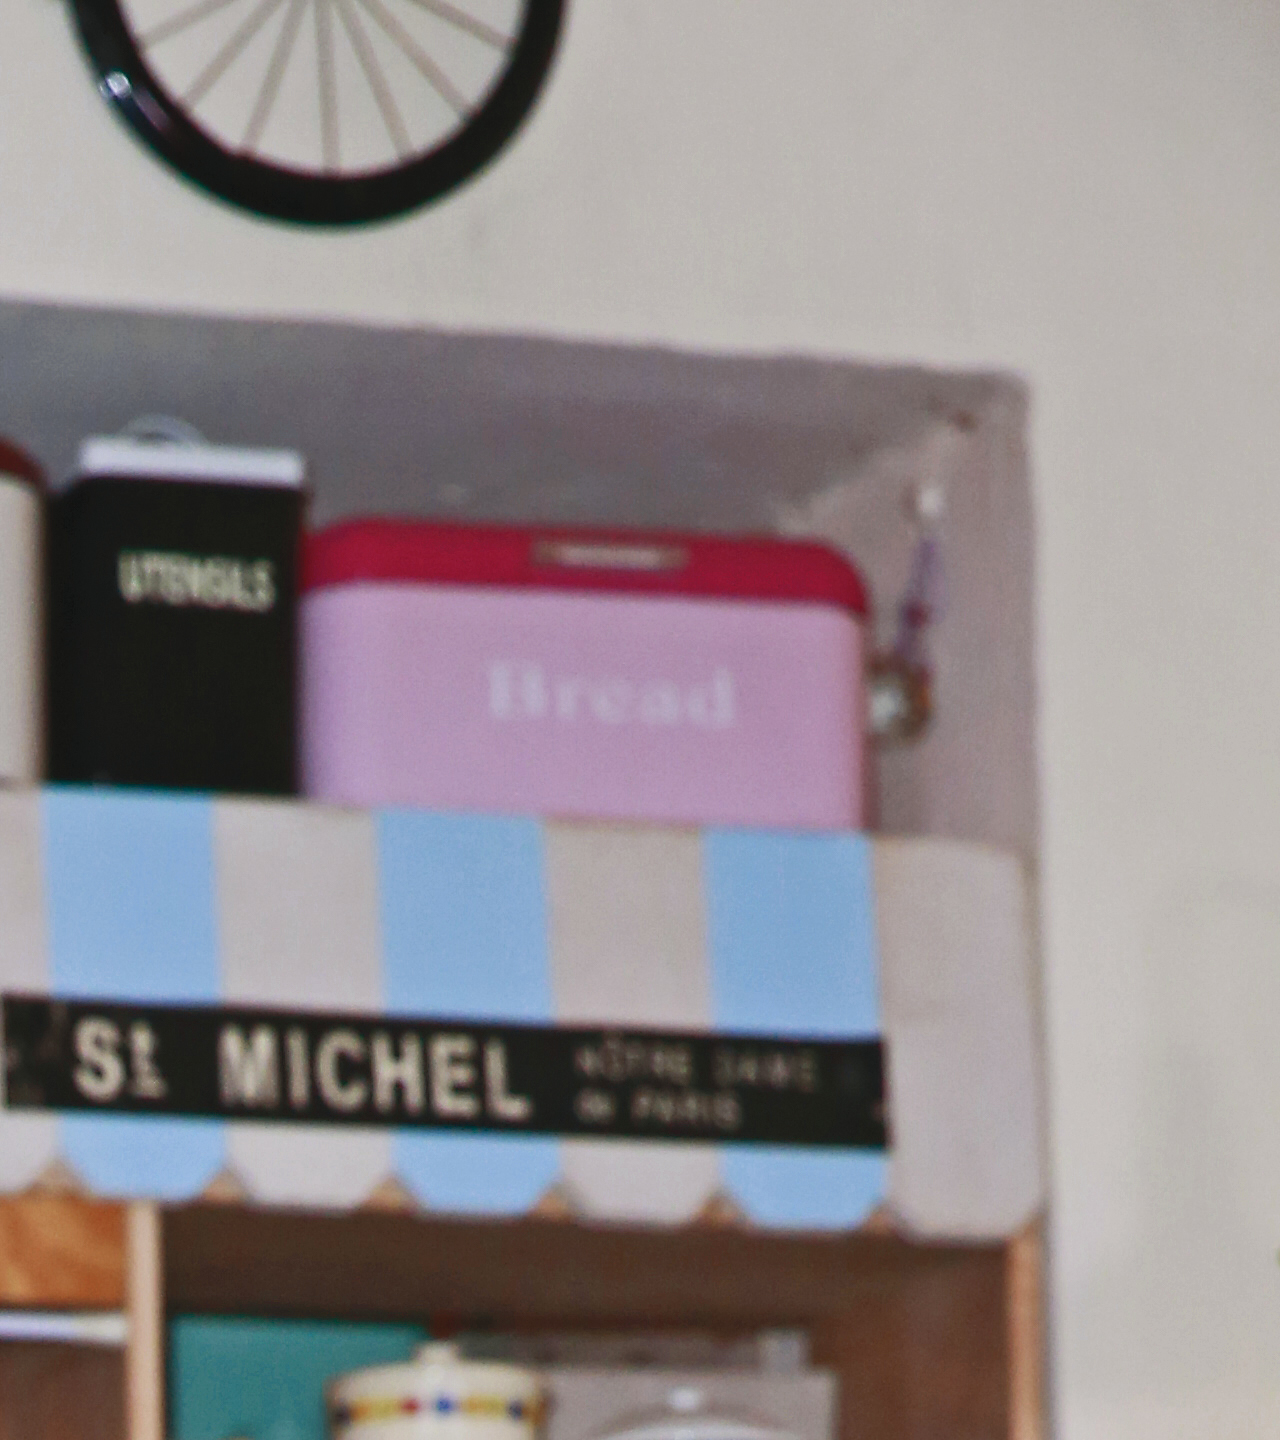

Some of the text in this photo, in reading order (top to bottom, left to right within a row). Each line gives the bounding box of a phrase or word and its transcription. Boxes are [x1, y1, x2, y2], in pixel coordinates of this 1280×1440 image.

[118, 548, 276, 612] UTENSILS
[485, 658, 737, 729] Bread
[219, 1024, 532, 1122] MICHEL
